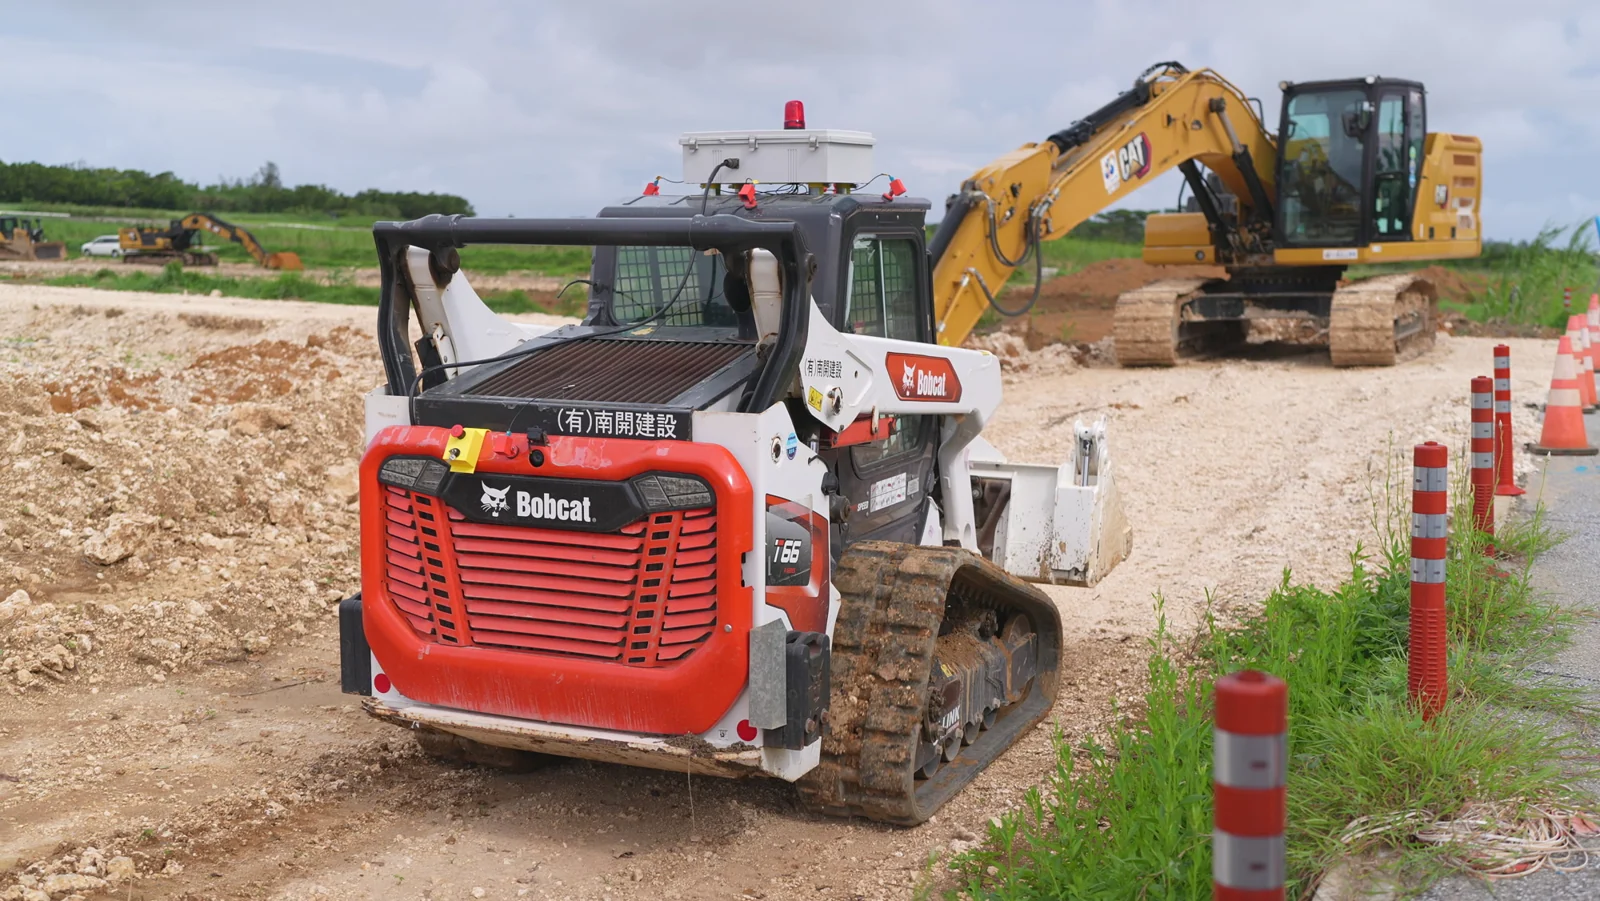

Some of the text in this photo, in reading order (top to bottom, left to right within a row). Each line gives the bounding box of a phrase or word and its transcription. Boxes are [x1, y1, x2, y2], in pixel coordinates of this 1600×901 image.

[1119, 134, 1145, 181] CAT
[917, 369, 946, 396] Bobcat
[557, 408, 677, 439] (有)南開建設
[516, 490, 591, 522] Bobcat
[773, 539, 802, 563] T66
